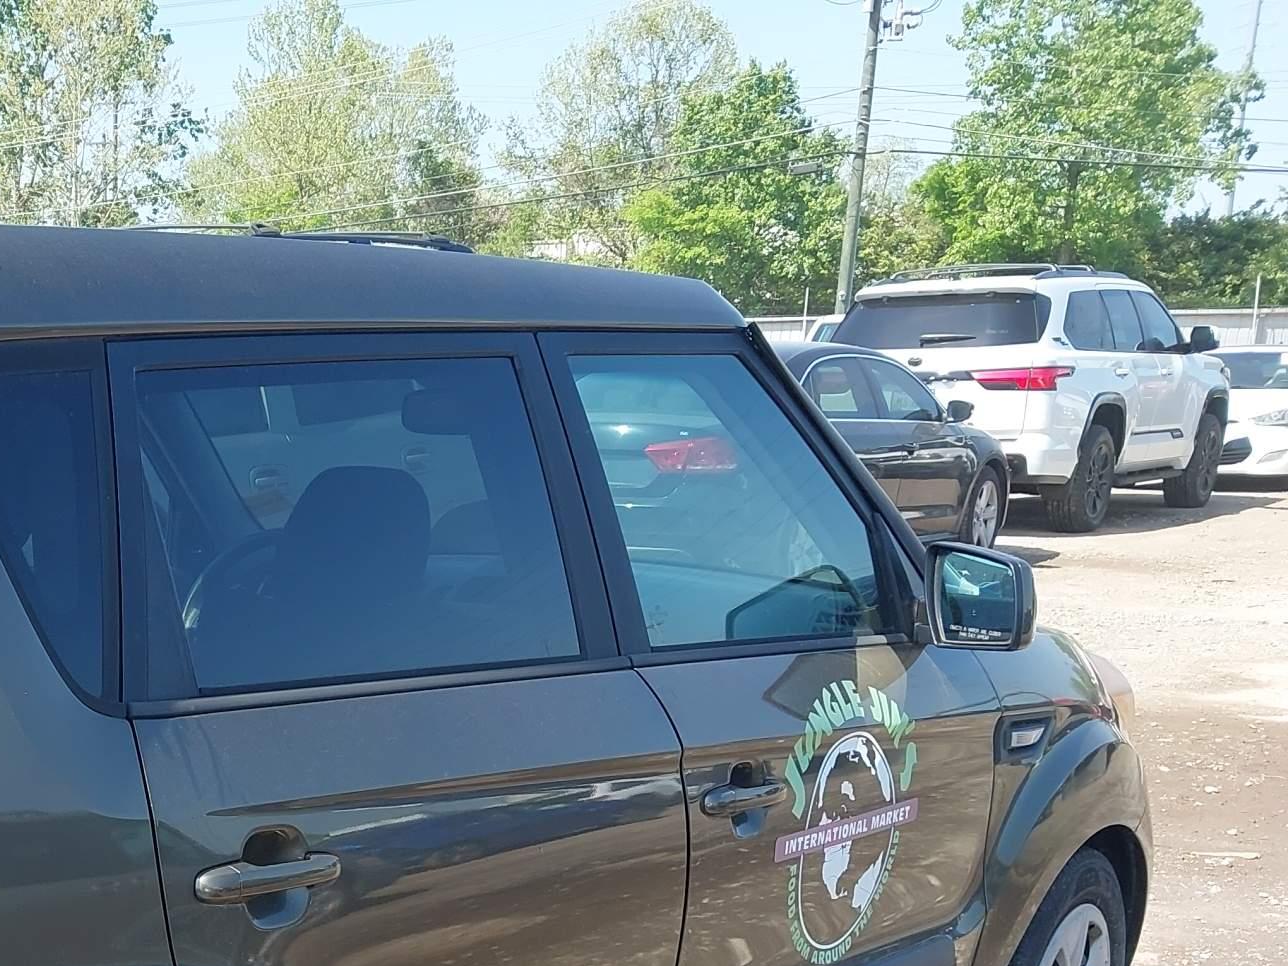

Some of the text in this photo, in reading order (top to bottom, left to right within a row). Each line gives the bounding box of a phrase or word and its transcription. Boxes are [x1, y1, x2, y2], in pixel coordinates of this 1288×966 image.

[784, 679, 865, 820] JUNGLE
[784, 805, 911, 855] INTERNATIONAL MARKET
[786, 831, 900, 965] FOOD FROM AROUND THE WORLD
